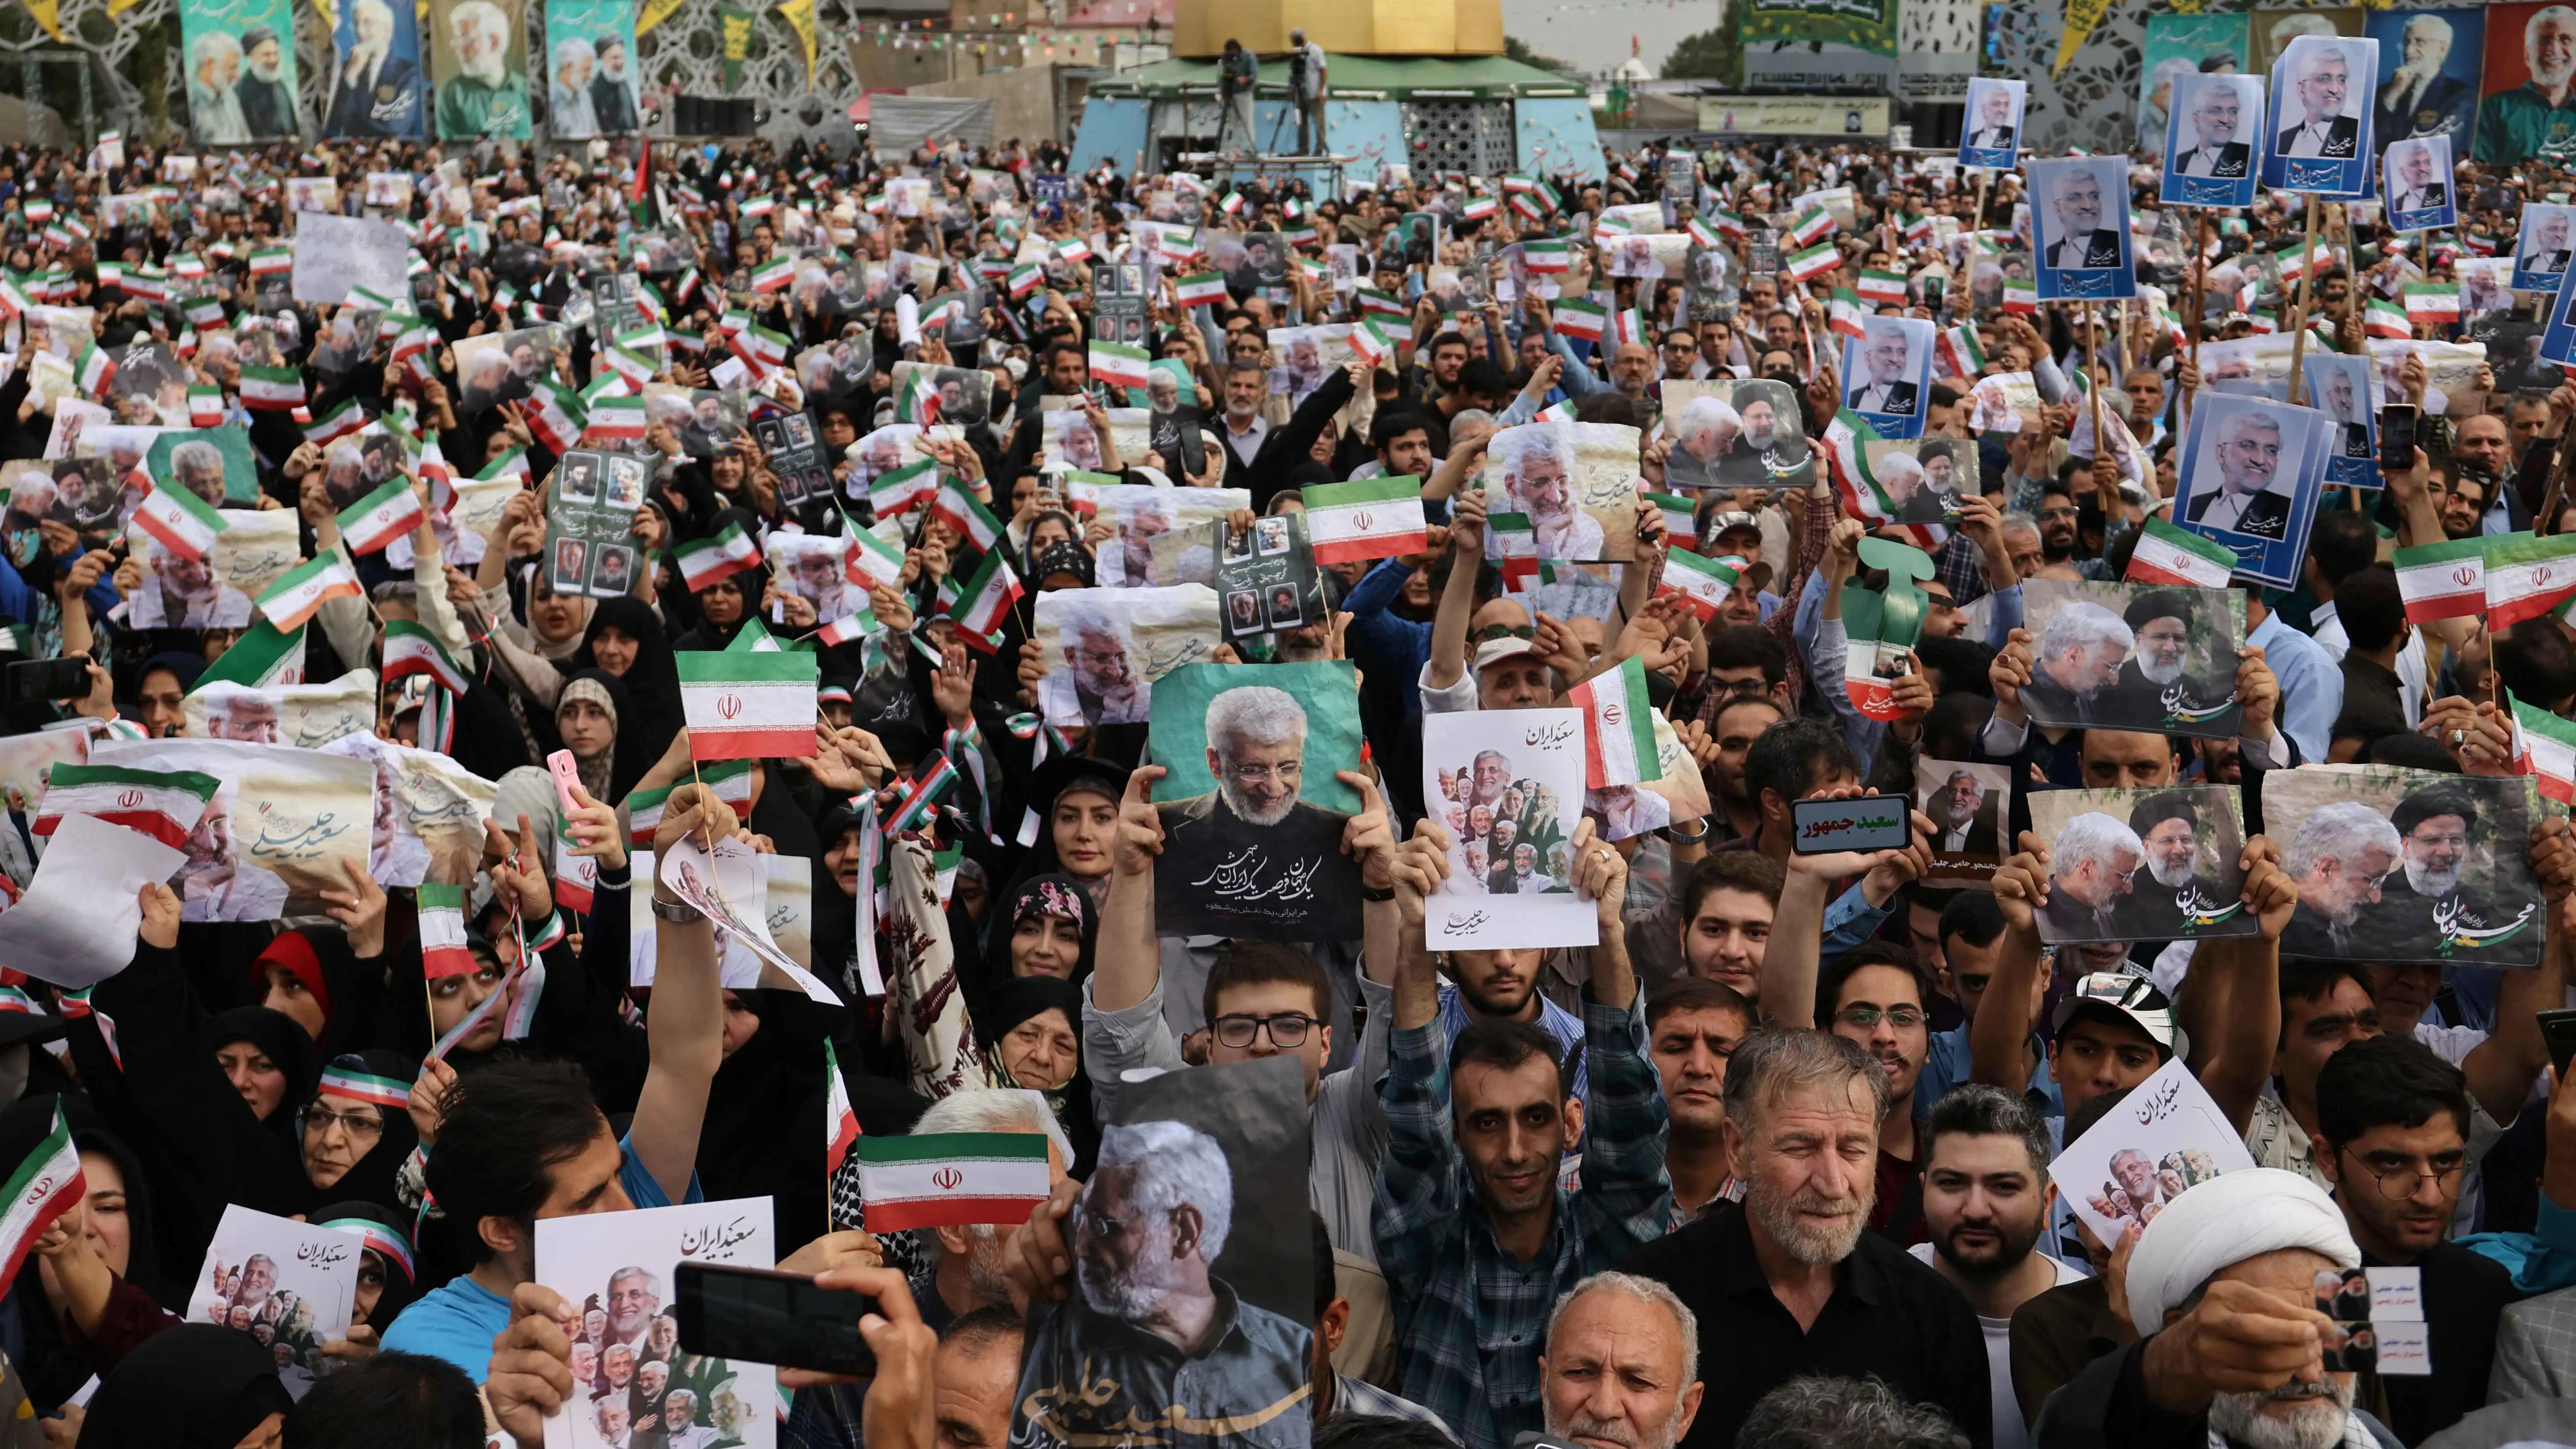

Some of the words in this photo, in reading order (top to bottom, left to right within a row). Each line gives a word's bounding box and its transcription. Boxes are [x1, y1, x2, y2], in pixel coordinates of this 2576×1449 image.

[1584, 472, 1629, 509] جلیلی
[1608, 482, 1636, 507] سعید
[2242, 515, 2279, 532] جلیلی
[2259, 521, 2284, 533] سعید
[1145, 639, 1197, 675] جلیلی
[1525, 724, 1554, 751] ایران
[1550, 719, 1575, 750] سعید
[251, 811, 336, 858] جلیلی
[294, 823, 351, 858] سعید
[1802, 818, 1855, 838] جمهور
[1856, 815, 1899, 833] سعید
[1190, 844, 1258, 886] جهش
[1214, 855, 1267, 895] یک
[1216, 866, 1247, 889] ایران
[1279, 854, 1322, 900] یک
[1289, 856, 1307, 891] جهان
[1234, 872, 1289, 900] فرصت
[1205, 903, 1238, 914] پرشکوه
[2176, 885, 2243, 921] رومان
[2433, 894, 2536, 942] محرومان
[1444, 909, 1482, 936] جلیلی
[1464, 915, 1490, 935] سعید
[2135, 1092, 2167, 1125] ایران
[2161, 1078, 2180, 1112] سعید
[681, 1223, 722, 1261] ایران
[715, 1215, 756, 1259] سعید
[297, 1240, 327, 1268] ایران
[319, 1243, 349, 1271] سعید
[1021, 1355, 1175, 1449] جلیلی
[1103, 1383, 1313, 1437] سعید
